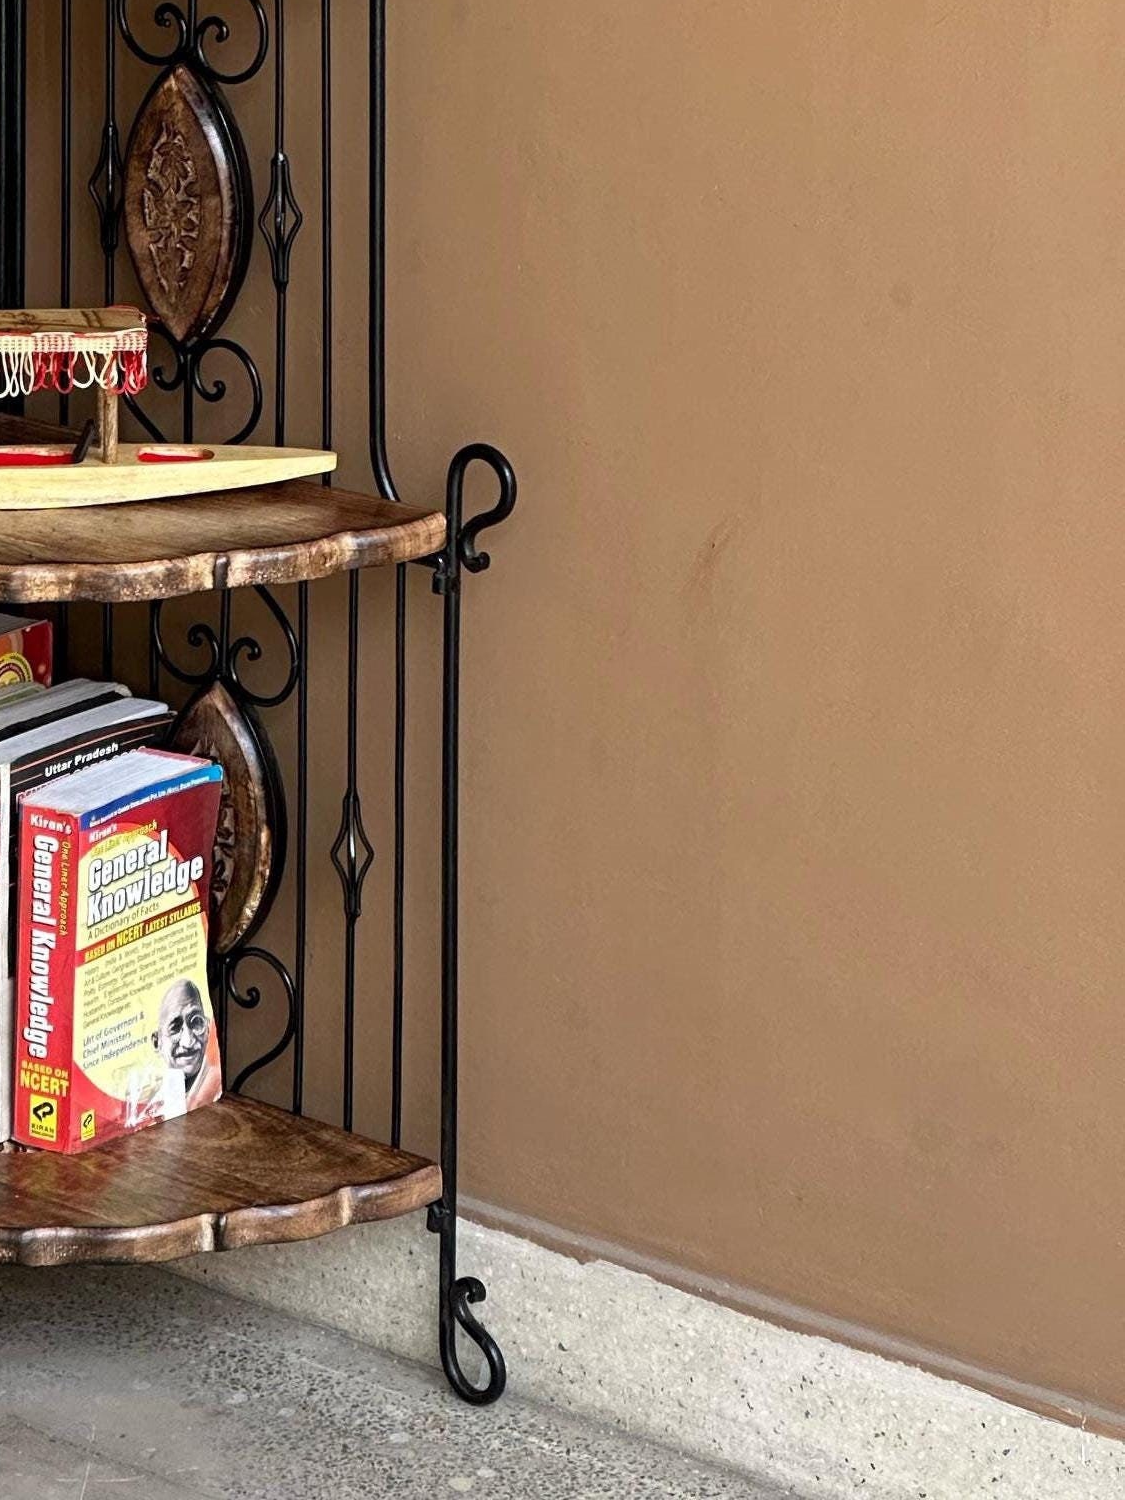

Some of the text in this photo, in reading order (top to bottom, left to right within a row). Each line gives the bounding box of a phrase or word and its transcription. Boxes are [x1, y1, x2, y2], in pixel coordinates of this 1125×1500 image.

[44, 742, 119, 777] Uttar Pradesh
[30, 812, 72, 835] Kiran's
[89, 823, 118, 843] Kiran's
[88, 829, 168, 893] General
[59, 840, 71, 937] One Liner Approach
[87, 855, 204, 928] Knowledge
[85, 901, 201, 962] BASED ON NCERT LATEST SYLLABUS
[95, 914, 130, 939] Dictionary
[140, 901, 160, 916] Facts
[23, 834, 60, 1060] General Knowledge
[104, 1016, 139, 1037] Governors
[82, 1035, 148, 1070] Since Independence
[83, 1031, 132, 1059] Chief Ministers
[20, 1073, 70, 1098] NCERT
[21, 1060, 69, 1079] BASED ON
[31, 1123, 55, 1134] KIRAN
